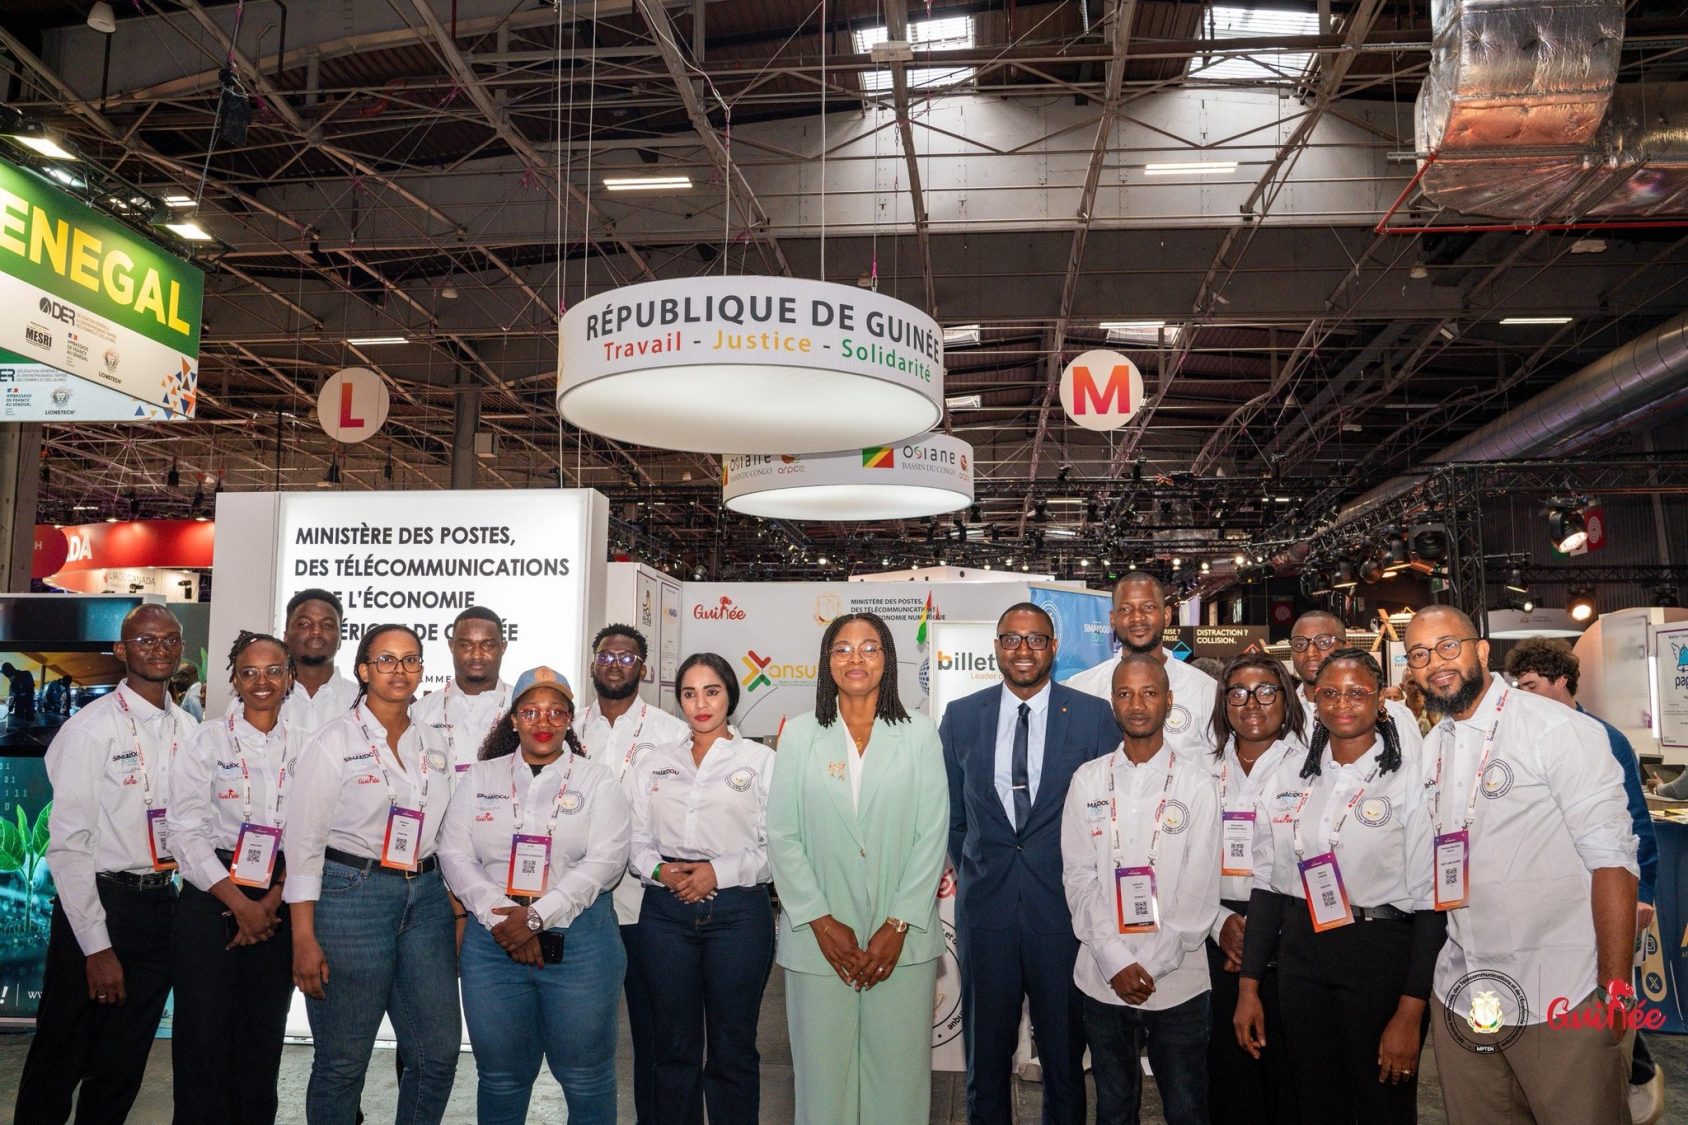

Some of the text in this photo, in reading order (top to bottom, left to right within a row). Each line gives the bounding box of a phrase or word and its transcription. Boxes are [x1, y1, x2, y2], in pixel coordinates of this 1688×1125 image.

[25, 328, 52, 348] MESRI
[587, 295, 939, 364] RÉPUBLIQUE DE GUINÉE
[604, 331, 681, 361] Travail
[713, 329, 812, 352] Justice
[842, 338, 931, 383] Solidarité
[1073, 365, 1131, 415] M
[340, 382, 365, 428] L
[296, 521, 516, 546] MINISTÈRE DES POSTES,
[294, 554, 570, 576] DES TÉLÉCOMMUNICATIONS
[694, 597, 746, 620] Guinée
[851, 597, 883, 605] MINISTÈRE
